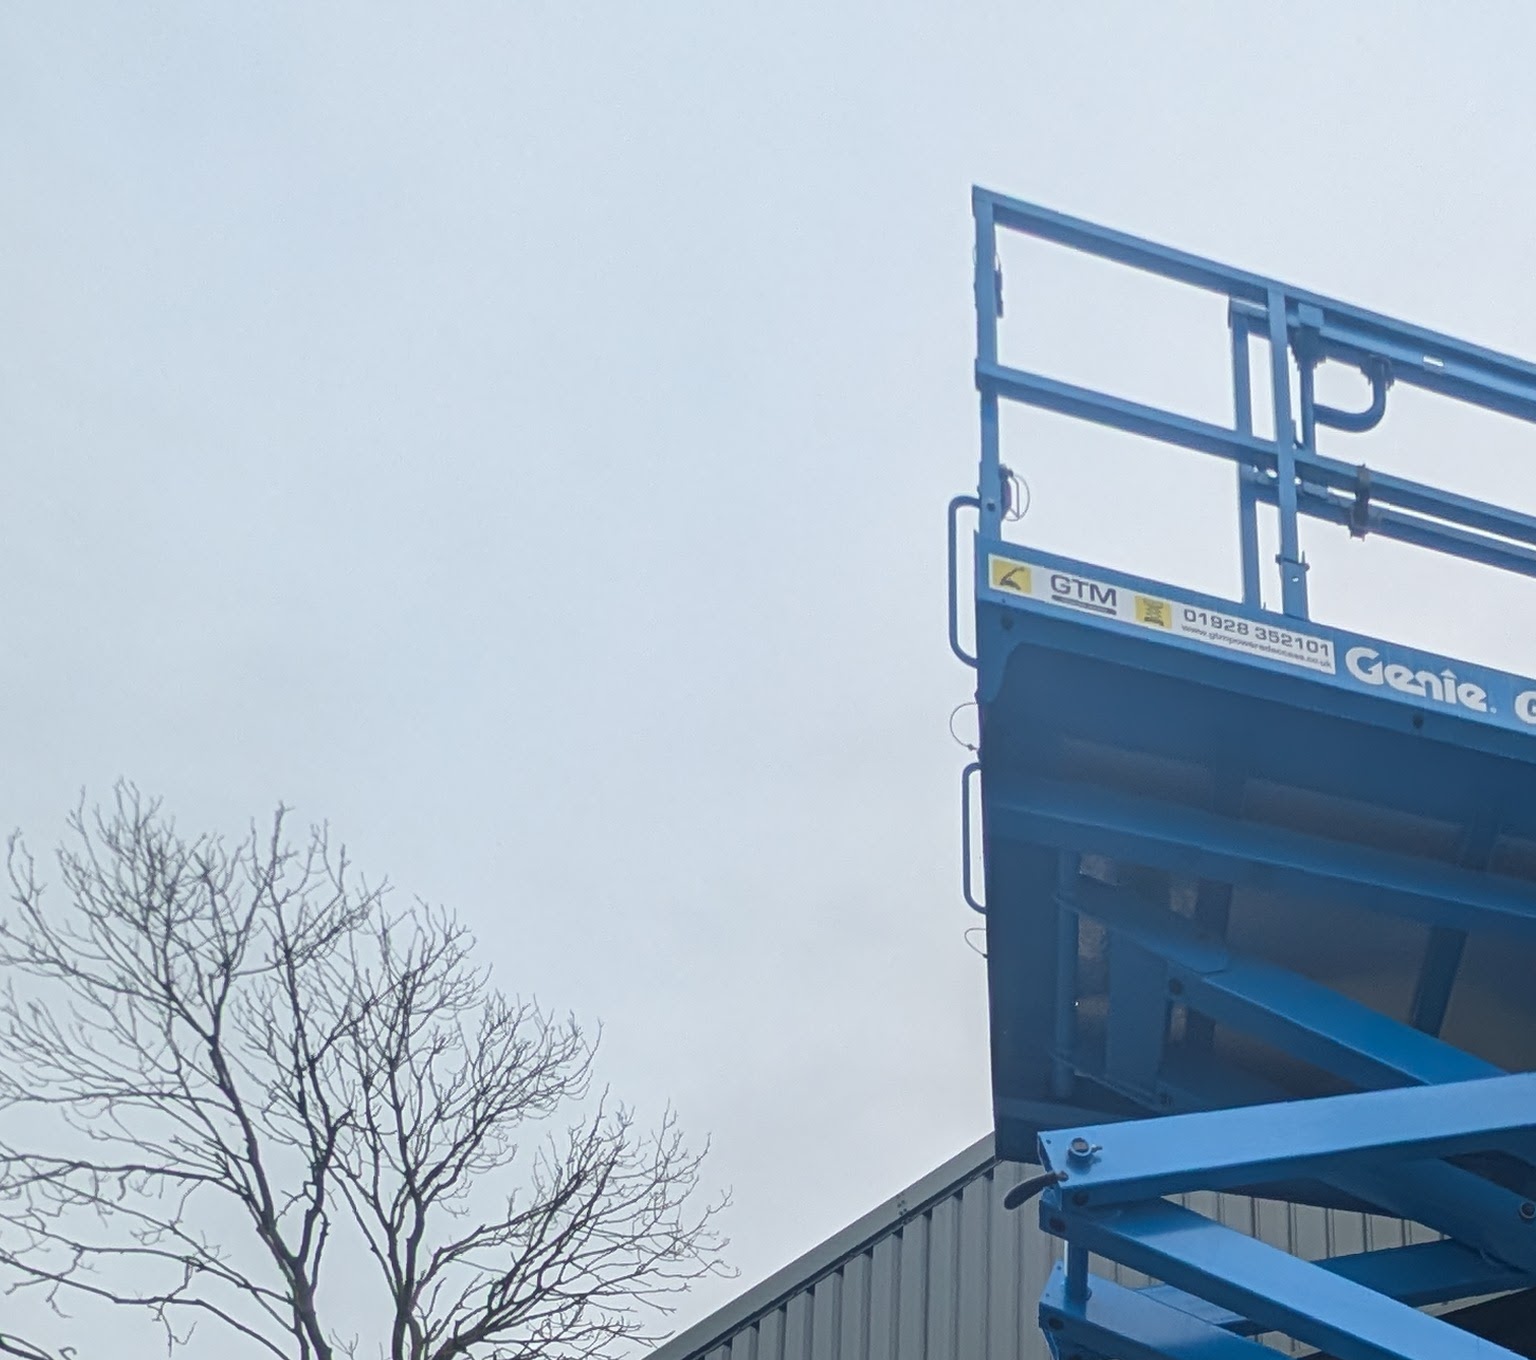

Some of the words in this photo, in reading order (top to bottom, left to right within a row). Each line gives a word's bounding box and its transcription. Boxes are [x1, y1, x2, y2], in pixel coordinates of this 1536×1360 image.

[1051, 574, 1117, 607] GTM
[1183, 609, 1250, 636] 01928
[1254, 626, 1330, 657] 352101
[1345, 646, 1488, 713] Genie
